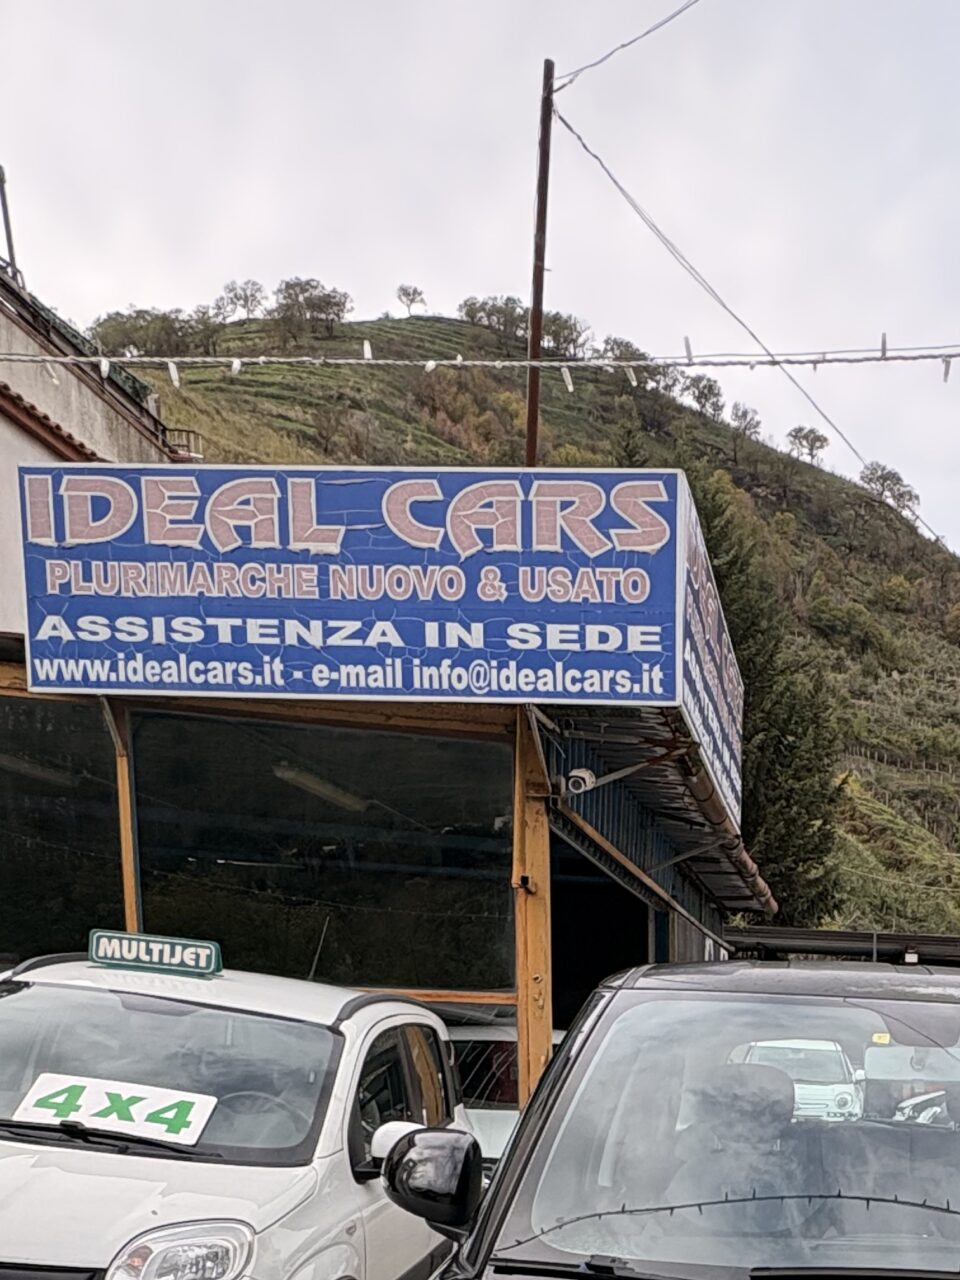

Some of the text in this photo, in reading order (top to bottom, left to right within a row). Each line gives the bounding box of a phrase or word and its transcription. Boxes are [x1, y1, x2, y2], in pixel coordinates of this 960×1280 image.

[24, 475, 670, 558] IDEAL CARS
[46, 560, 650, 604] PLURIMARCHE NUOVO & USATO
[35, 615, 662, 651] ASSISTENZA IN SEDE
[34, 653, 285, 686] www.idealcars.it
[312, 659, 402, 688] e-mail
[413, 659, 664, 694] info@idealcars.it
[98, 937, 210, 967] MULTIJET
